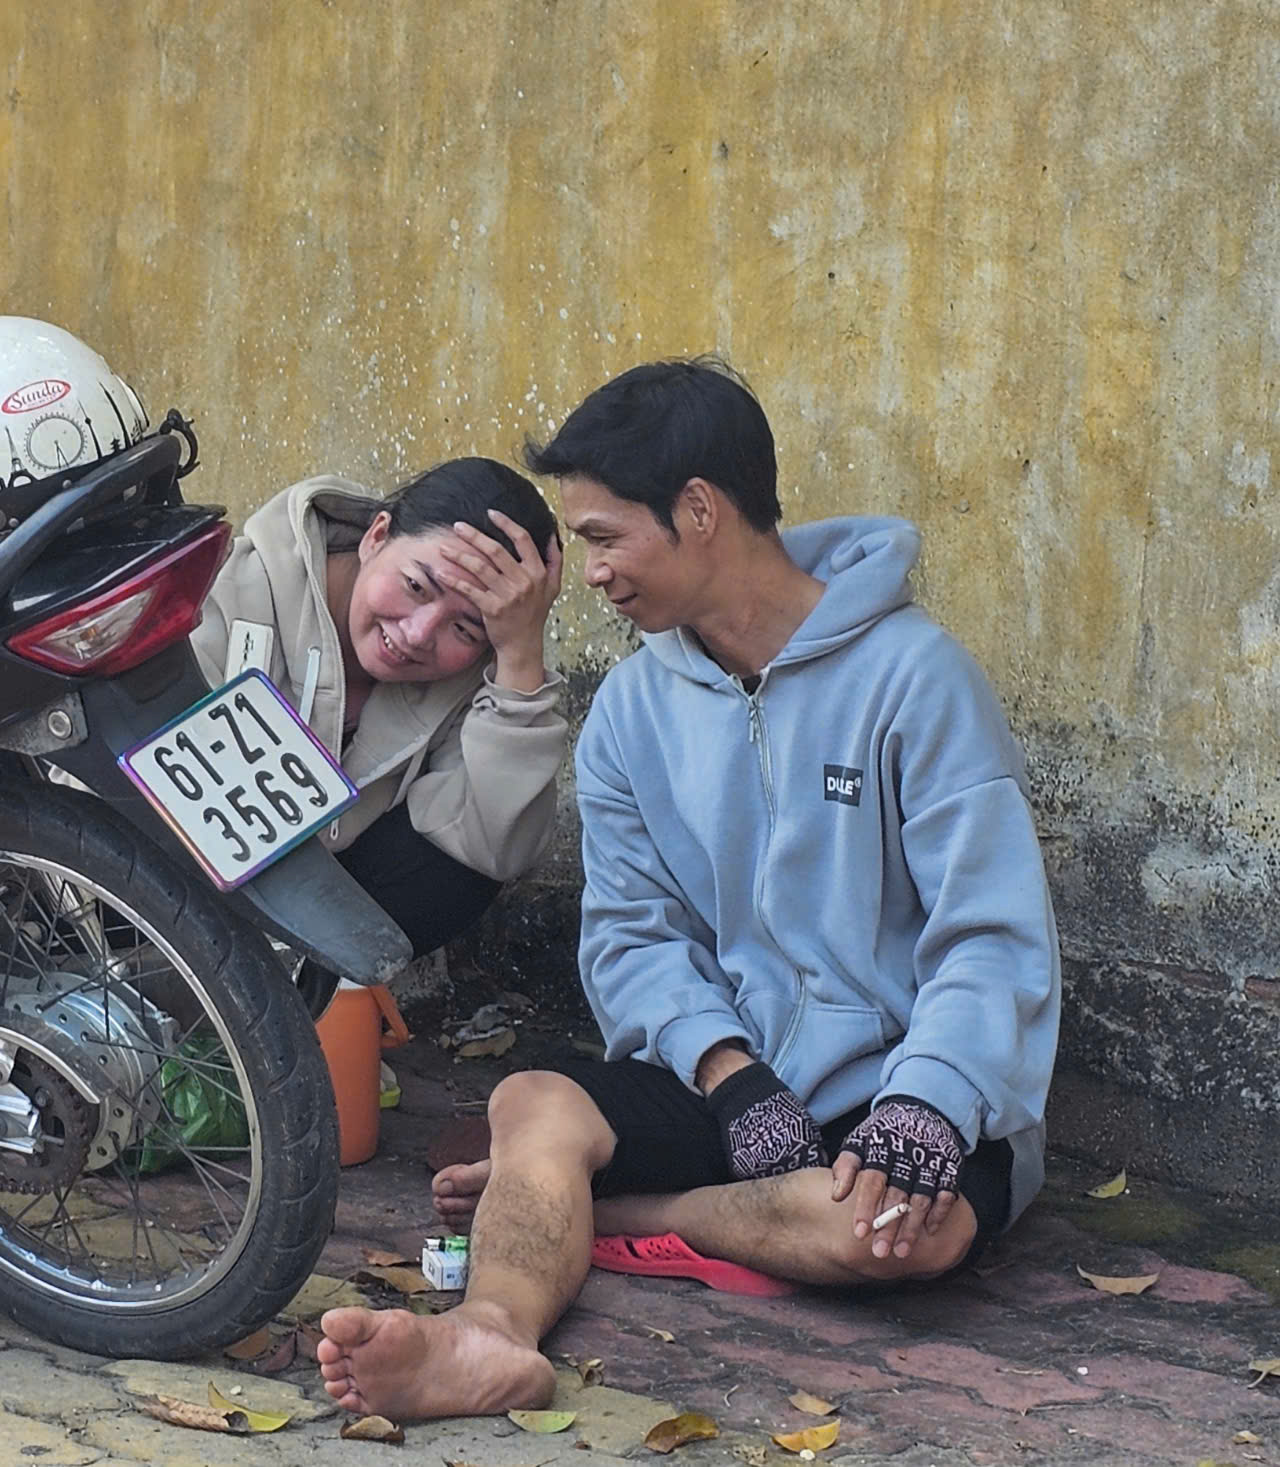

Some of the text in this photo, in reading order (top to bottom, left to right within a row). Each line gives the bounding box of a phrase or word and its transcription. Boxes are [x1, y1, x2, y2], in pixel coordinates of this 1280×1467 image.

[8, 380, 62, 410] Sunda
[153, 692, 282, 802] 61-Z1
[203, 752, 329, 863] 3569
